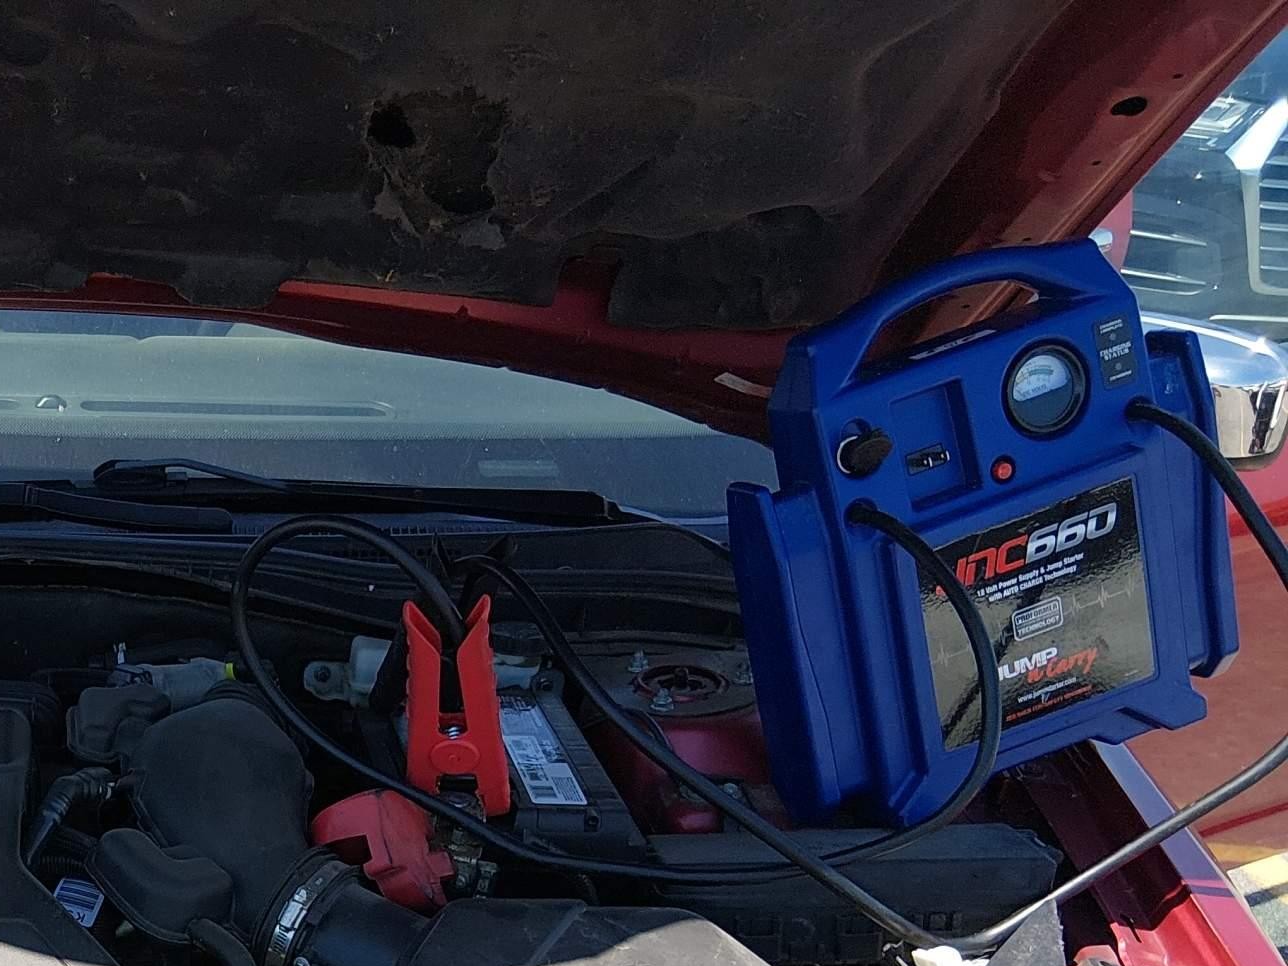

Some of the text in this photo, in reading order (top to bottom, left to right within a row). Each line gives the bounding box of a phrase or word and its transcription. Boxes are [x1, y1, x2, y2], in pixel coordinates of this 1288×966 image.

[985, 584, 998, 595] Volt
[998, 577, 1018, 590] Power
[1018, 569, 1039, 583] Supply
[1046, 560, 1063, 572] Jump
[1063, 552, 1084, 565] Starter
[988, 565, 1077, 602] with AUTO CHARGE Technology
